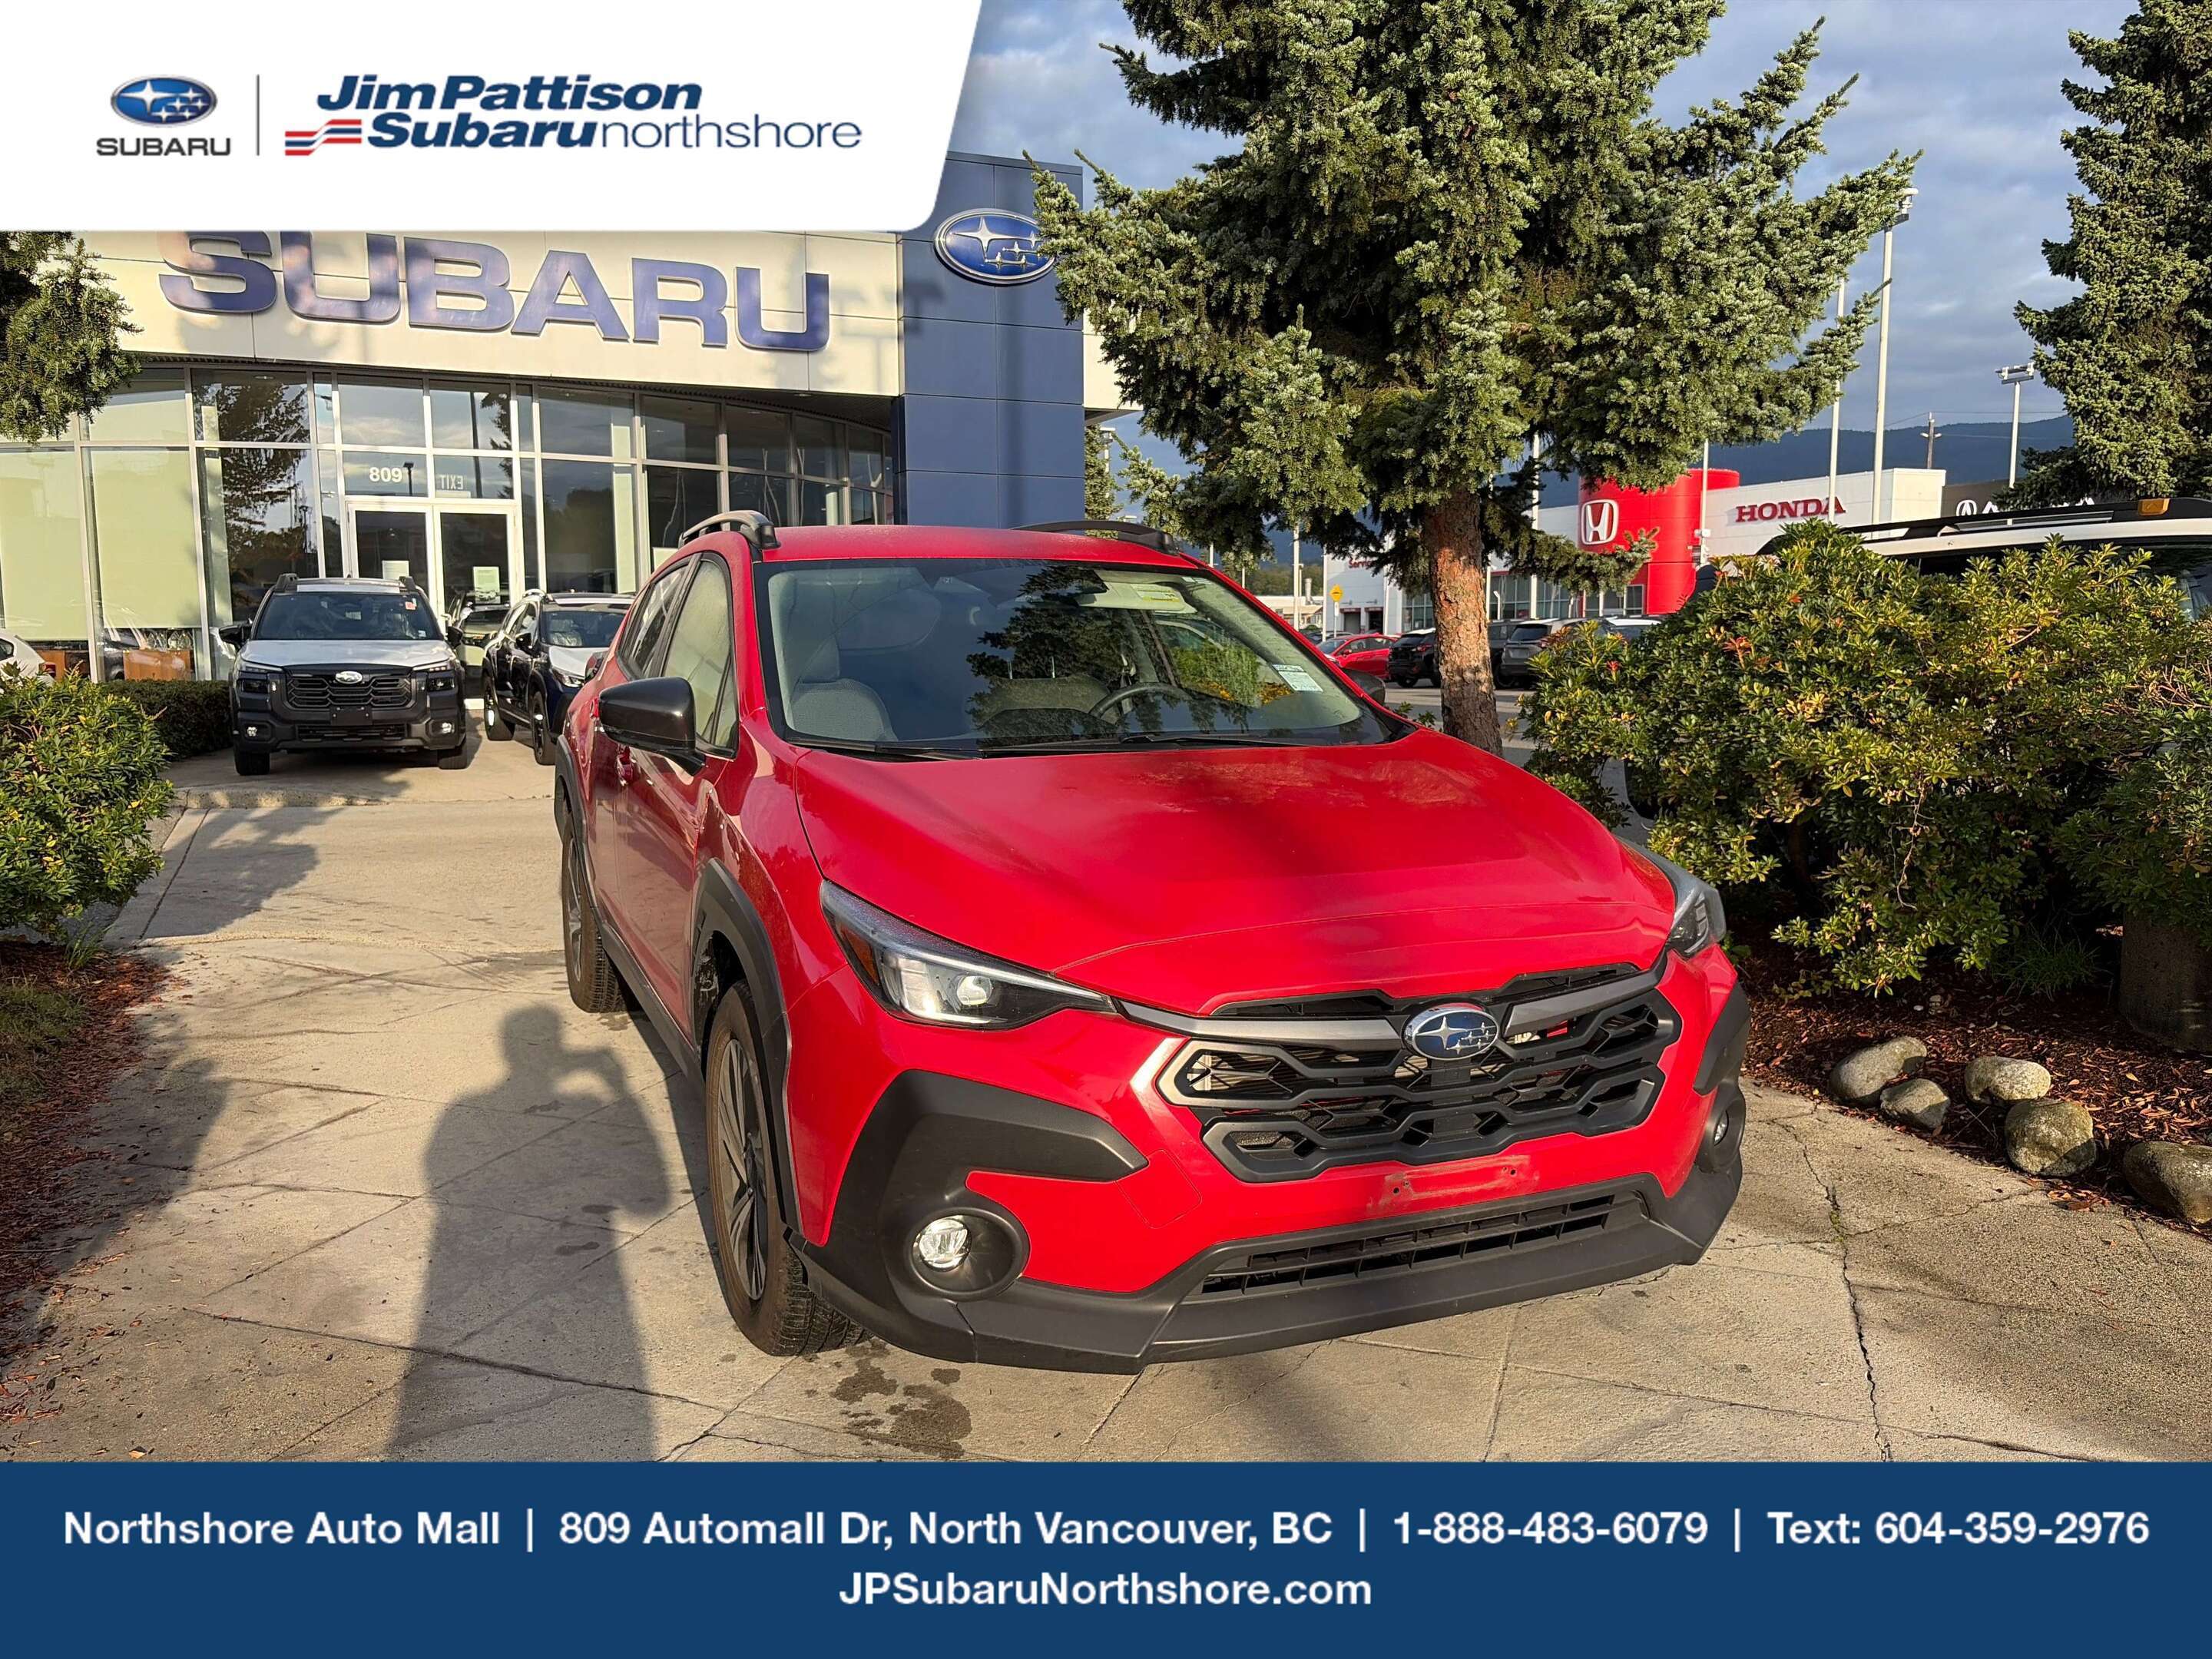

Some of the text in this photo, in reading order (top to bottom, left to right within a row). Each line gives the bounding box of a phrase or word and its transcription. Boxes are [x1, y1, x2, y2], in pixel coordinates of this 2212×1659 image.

[157, 230, 830, 352] SUBARU
[369, 466, 402, 483] 809
[1735, 496, 1846, 523] HONDA
